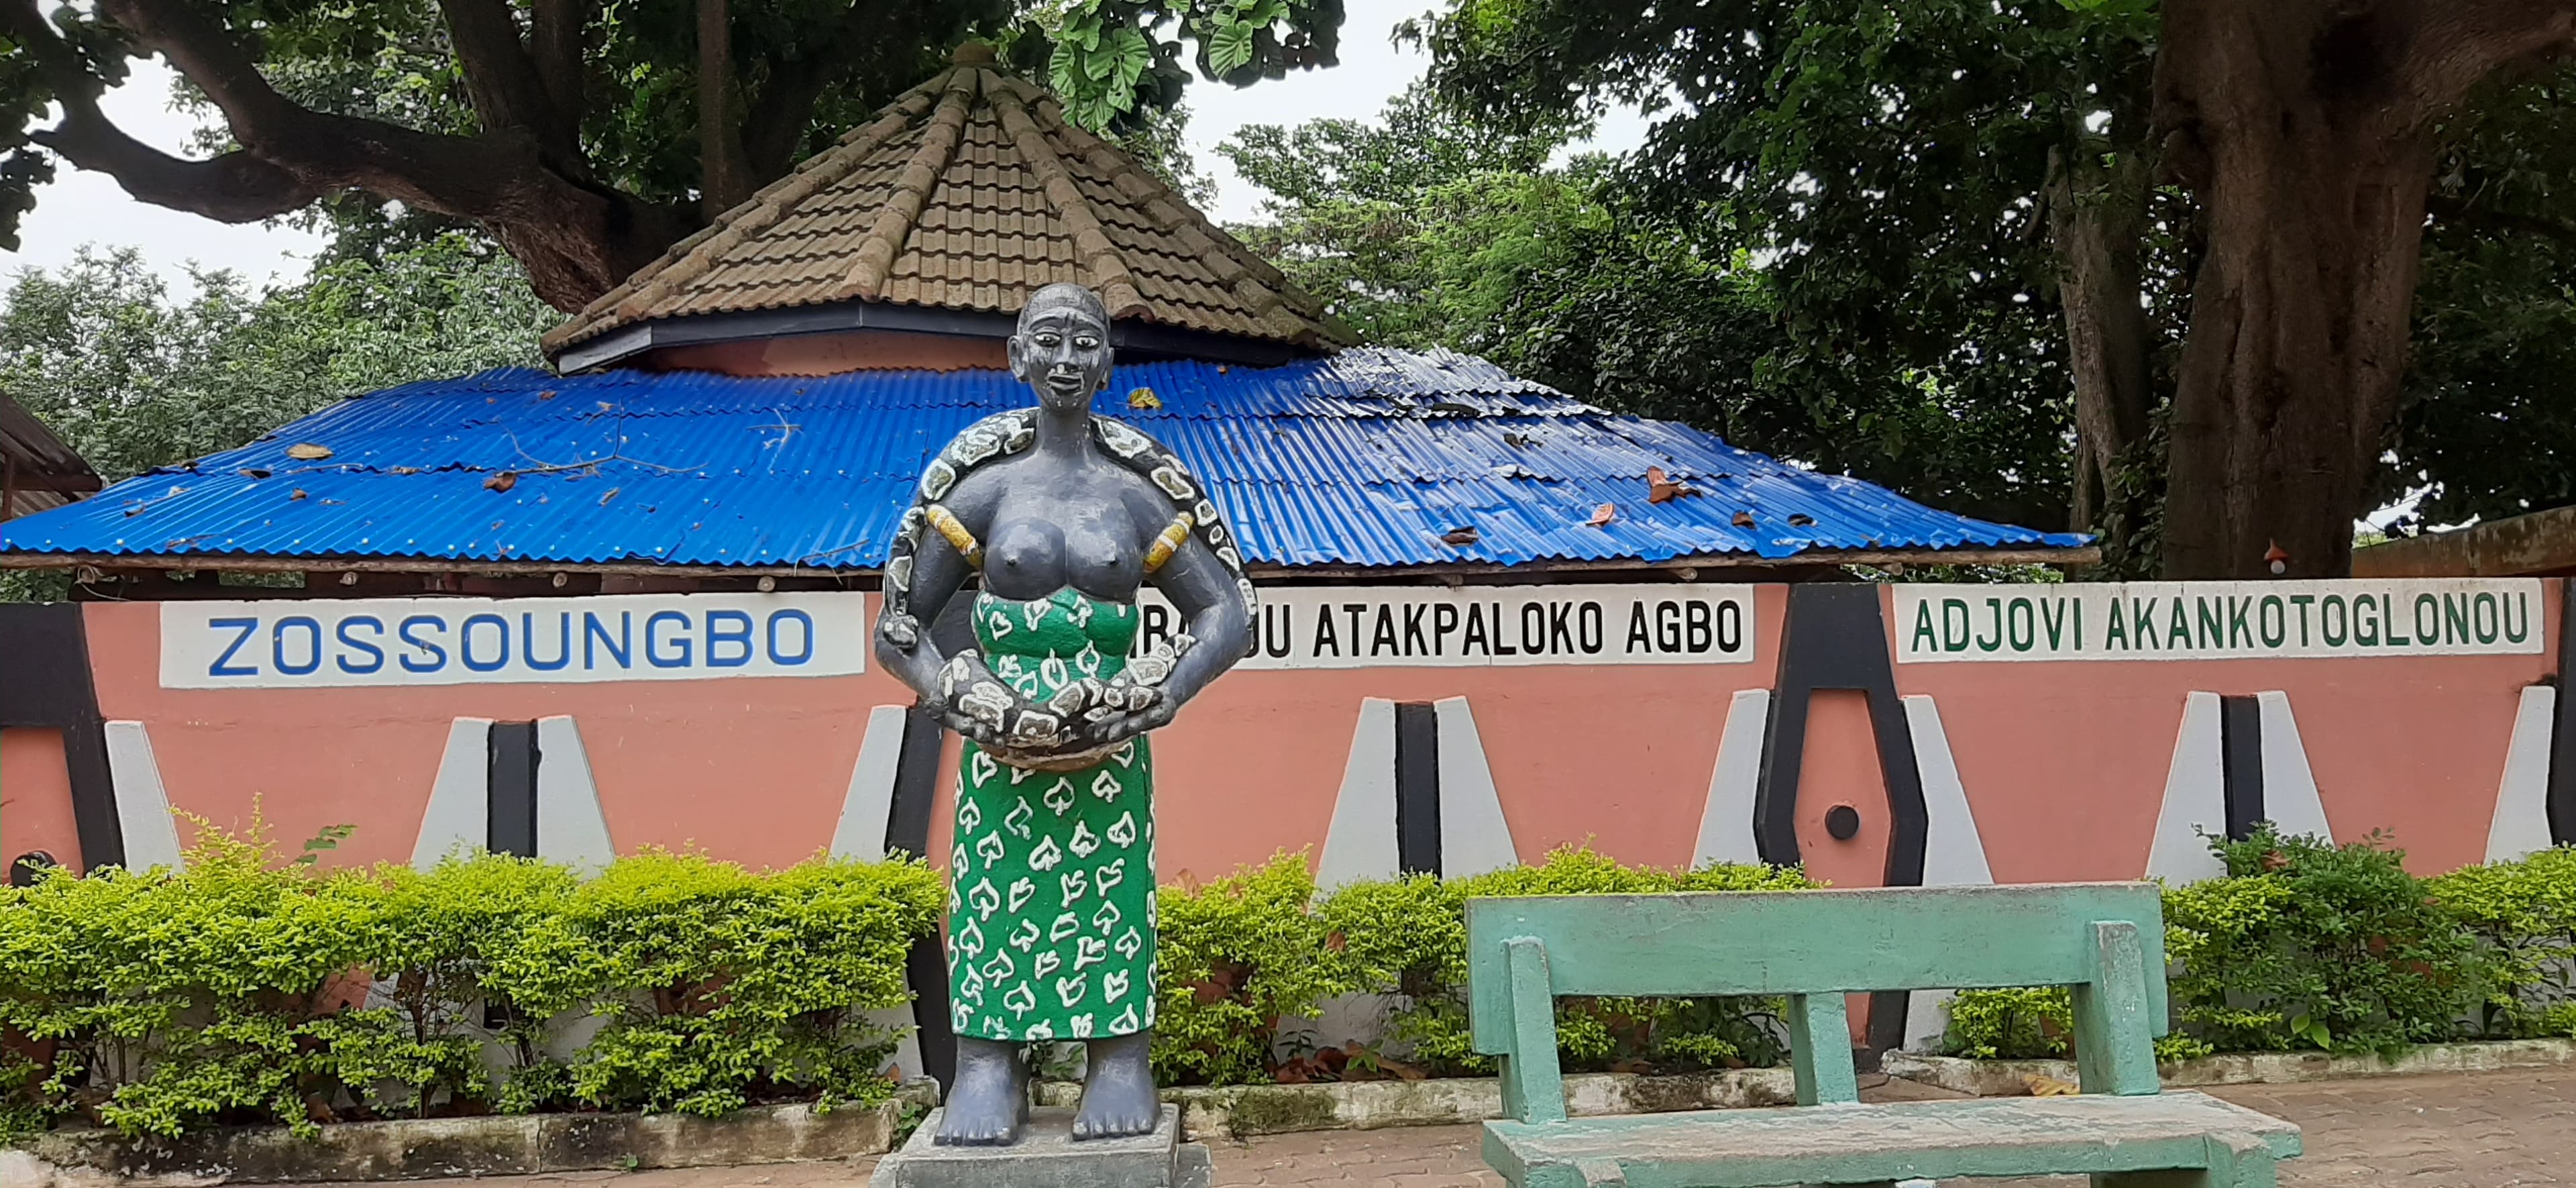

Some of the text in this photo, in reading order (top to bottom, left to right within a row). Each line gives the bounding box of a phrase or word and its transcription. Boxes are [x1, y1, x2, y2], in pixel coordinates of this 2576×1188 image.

[209, 608, 814, 678] ZOSSOUNGBO
[1312, 600, 1603, 658] ATAKPALOKO
[1625, 599, 1741, 654] AGBO
[1911, 591, 2528, 653] ADJOVI AKANKOTOGLONOU
